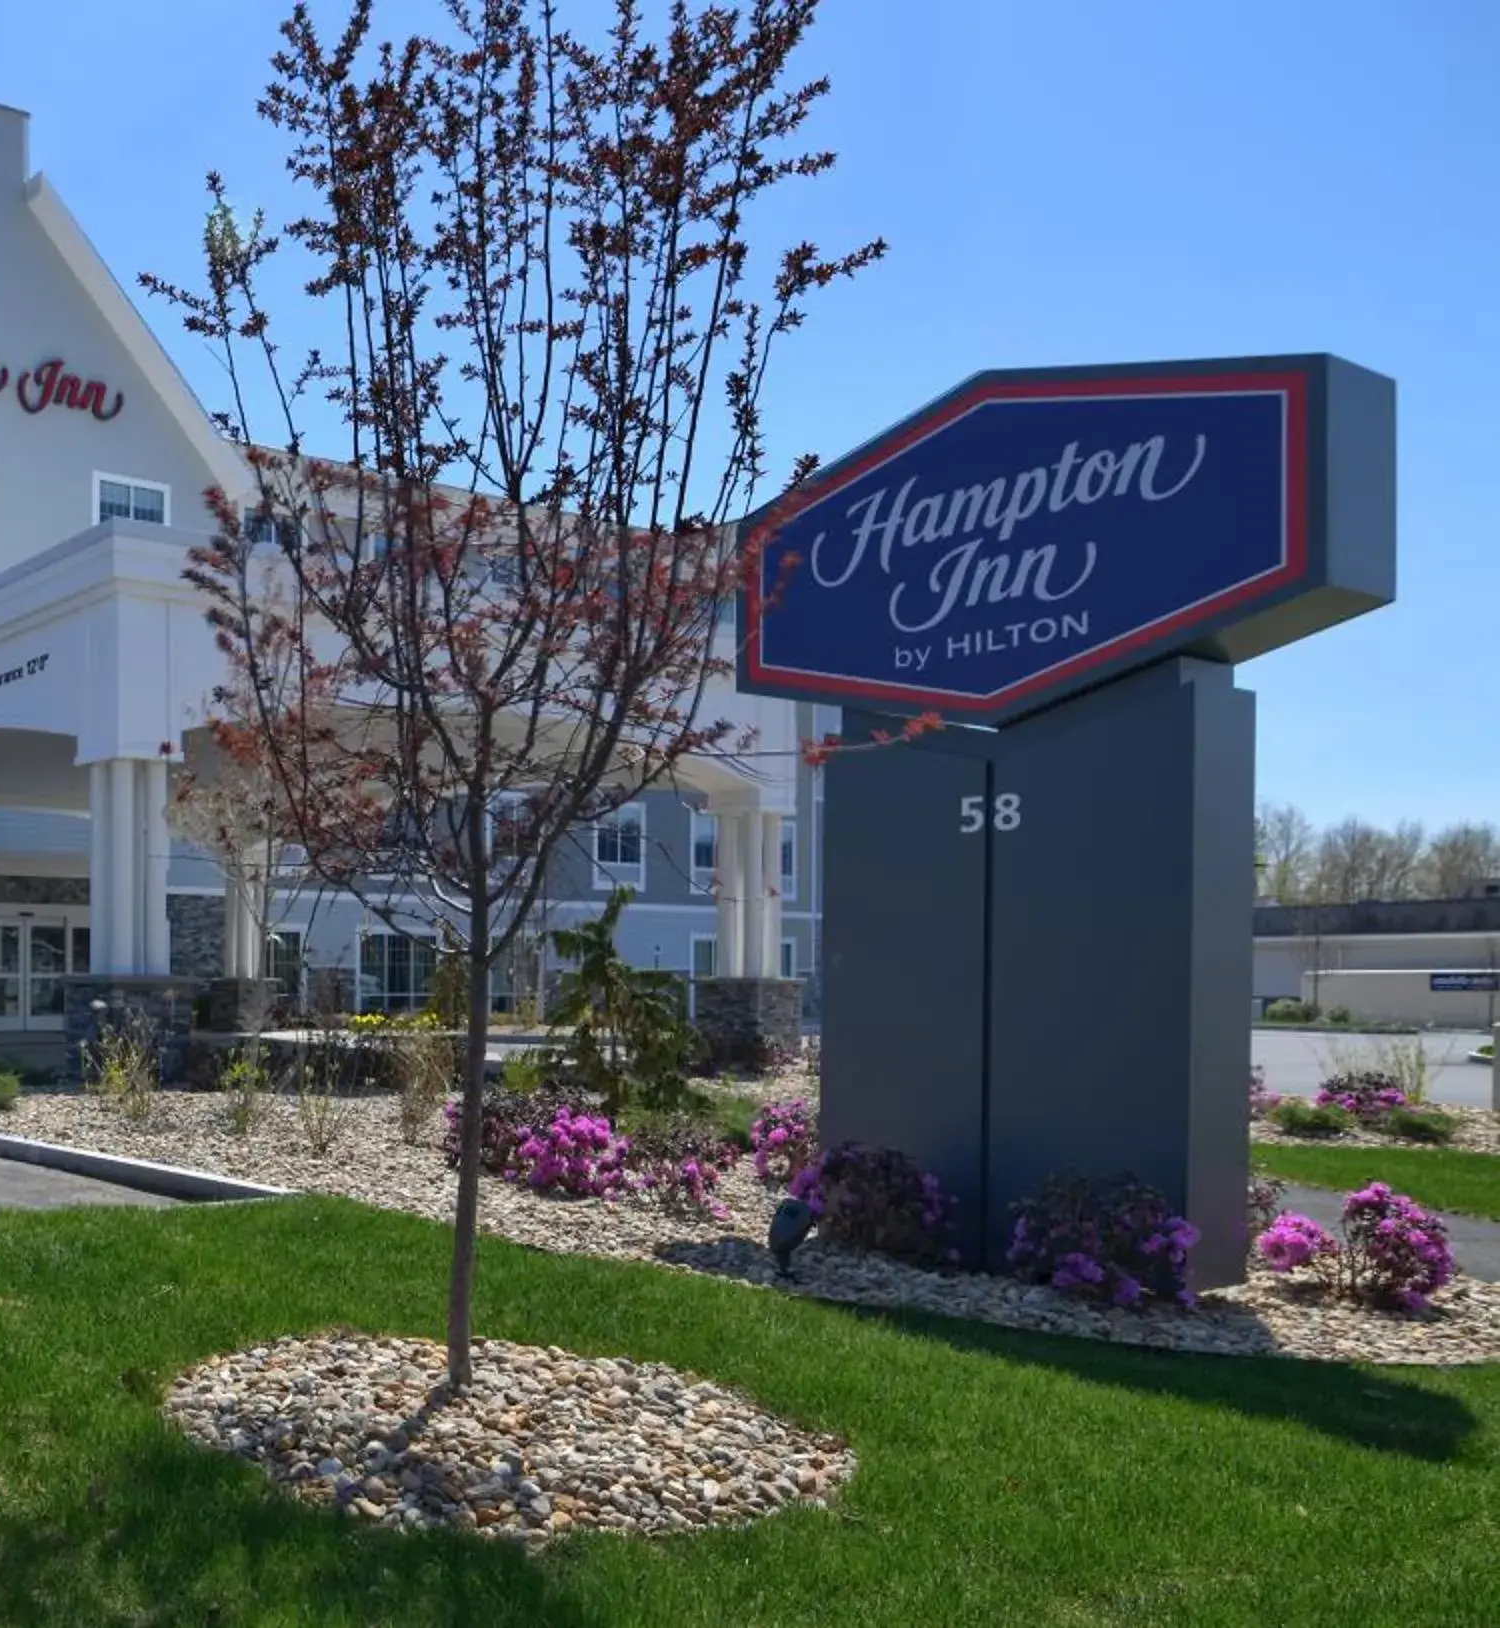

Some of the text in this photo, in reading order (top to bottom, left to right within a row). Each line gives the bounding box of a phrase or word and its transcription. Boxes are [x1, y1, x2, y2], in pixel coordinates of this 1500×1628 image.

[17, 359, 123, 421] Inn
[811, 433, 1206, 588] Hampton
[889, 537, 1097, 633] Inn
[894, 609, 1089, 671] by HILTON
[960, 793, 1021, 832] 58
